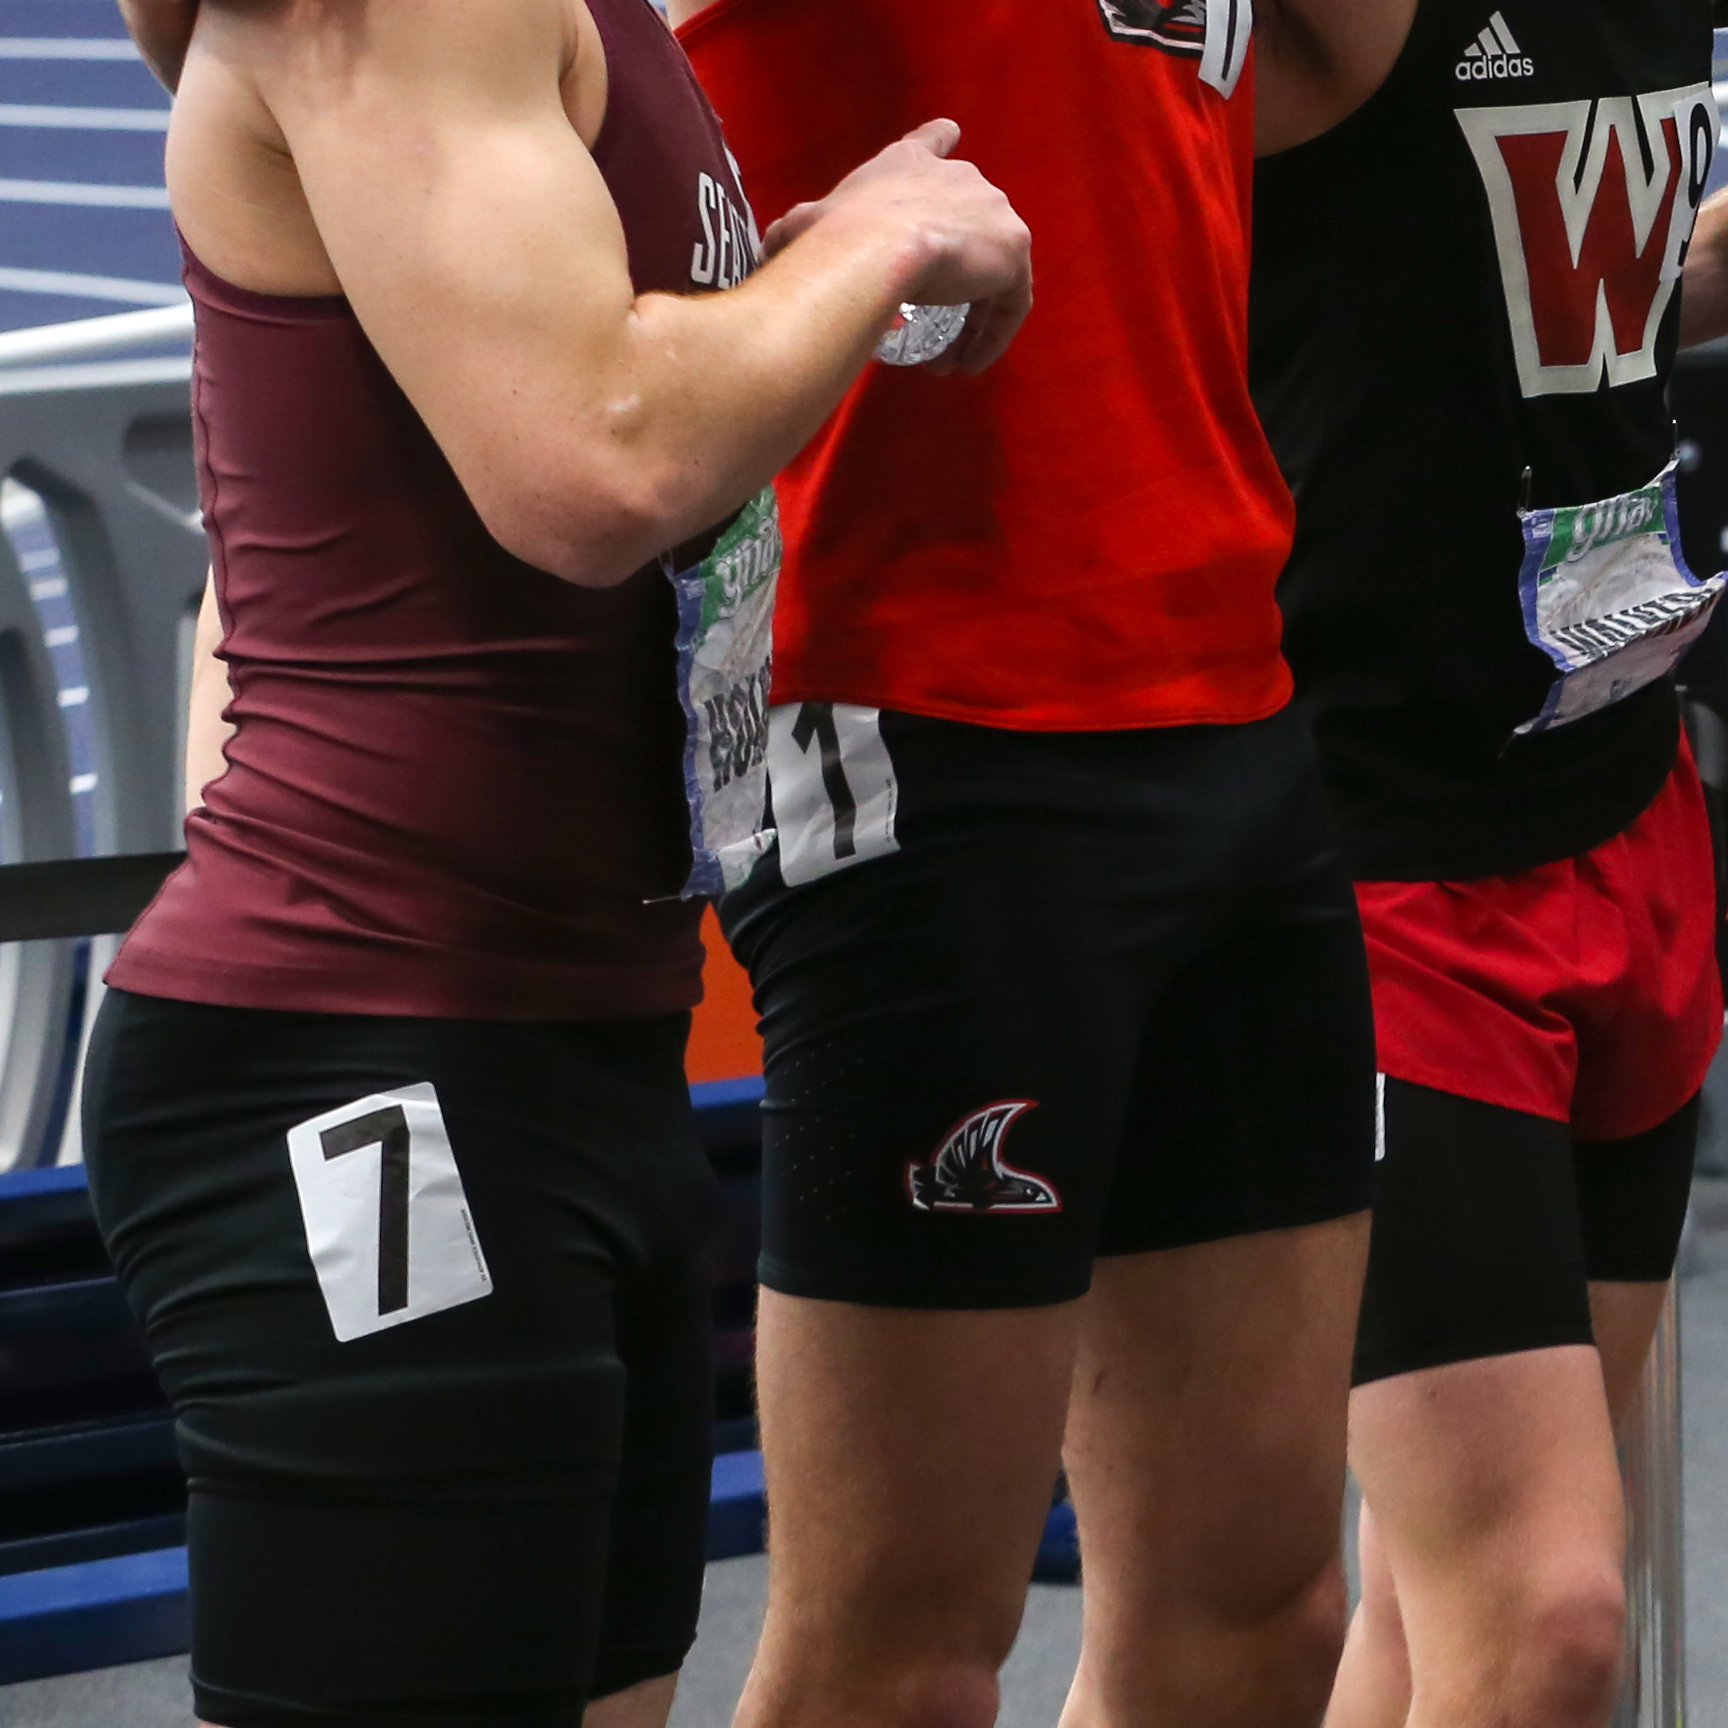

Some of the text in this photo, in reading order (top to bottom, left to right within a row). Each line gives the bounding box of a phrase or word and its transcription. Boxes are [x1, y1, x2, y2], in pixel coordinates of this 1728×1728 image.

[1455, 54, 1535, 82] adidas
[1453, 81, 1712, 398] W
[792, 701, 856, 860] 1
[318, 1103, 411, 1317] 7
